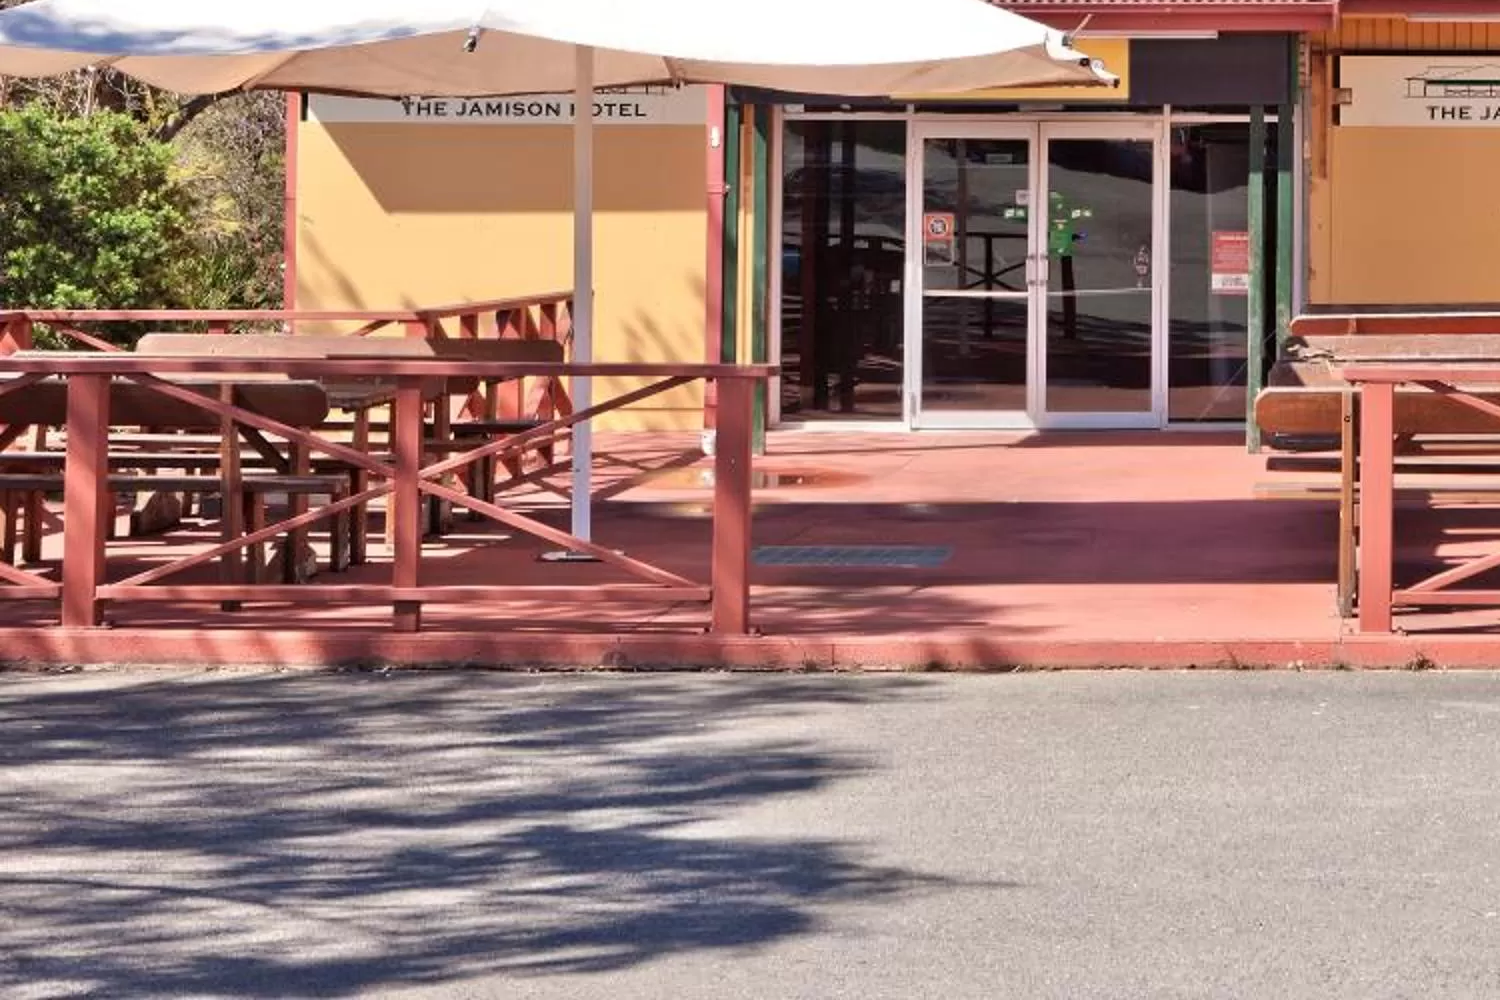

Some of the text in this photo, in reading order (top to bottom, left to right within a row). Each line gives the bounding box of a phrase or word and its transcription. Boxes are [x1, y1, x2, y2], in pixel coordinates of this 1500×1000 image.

[402, 101, 448, 116] THE
[456, 102, 561, 117] JAMISON
[1426, 105, 1472, 120] THE
